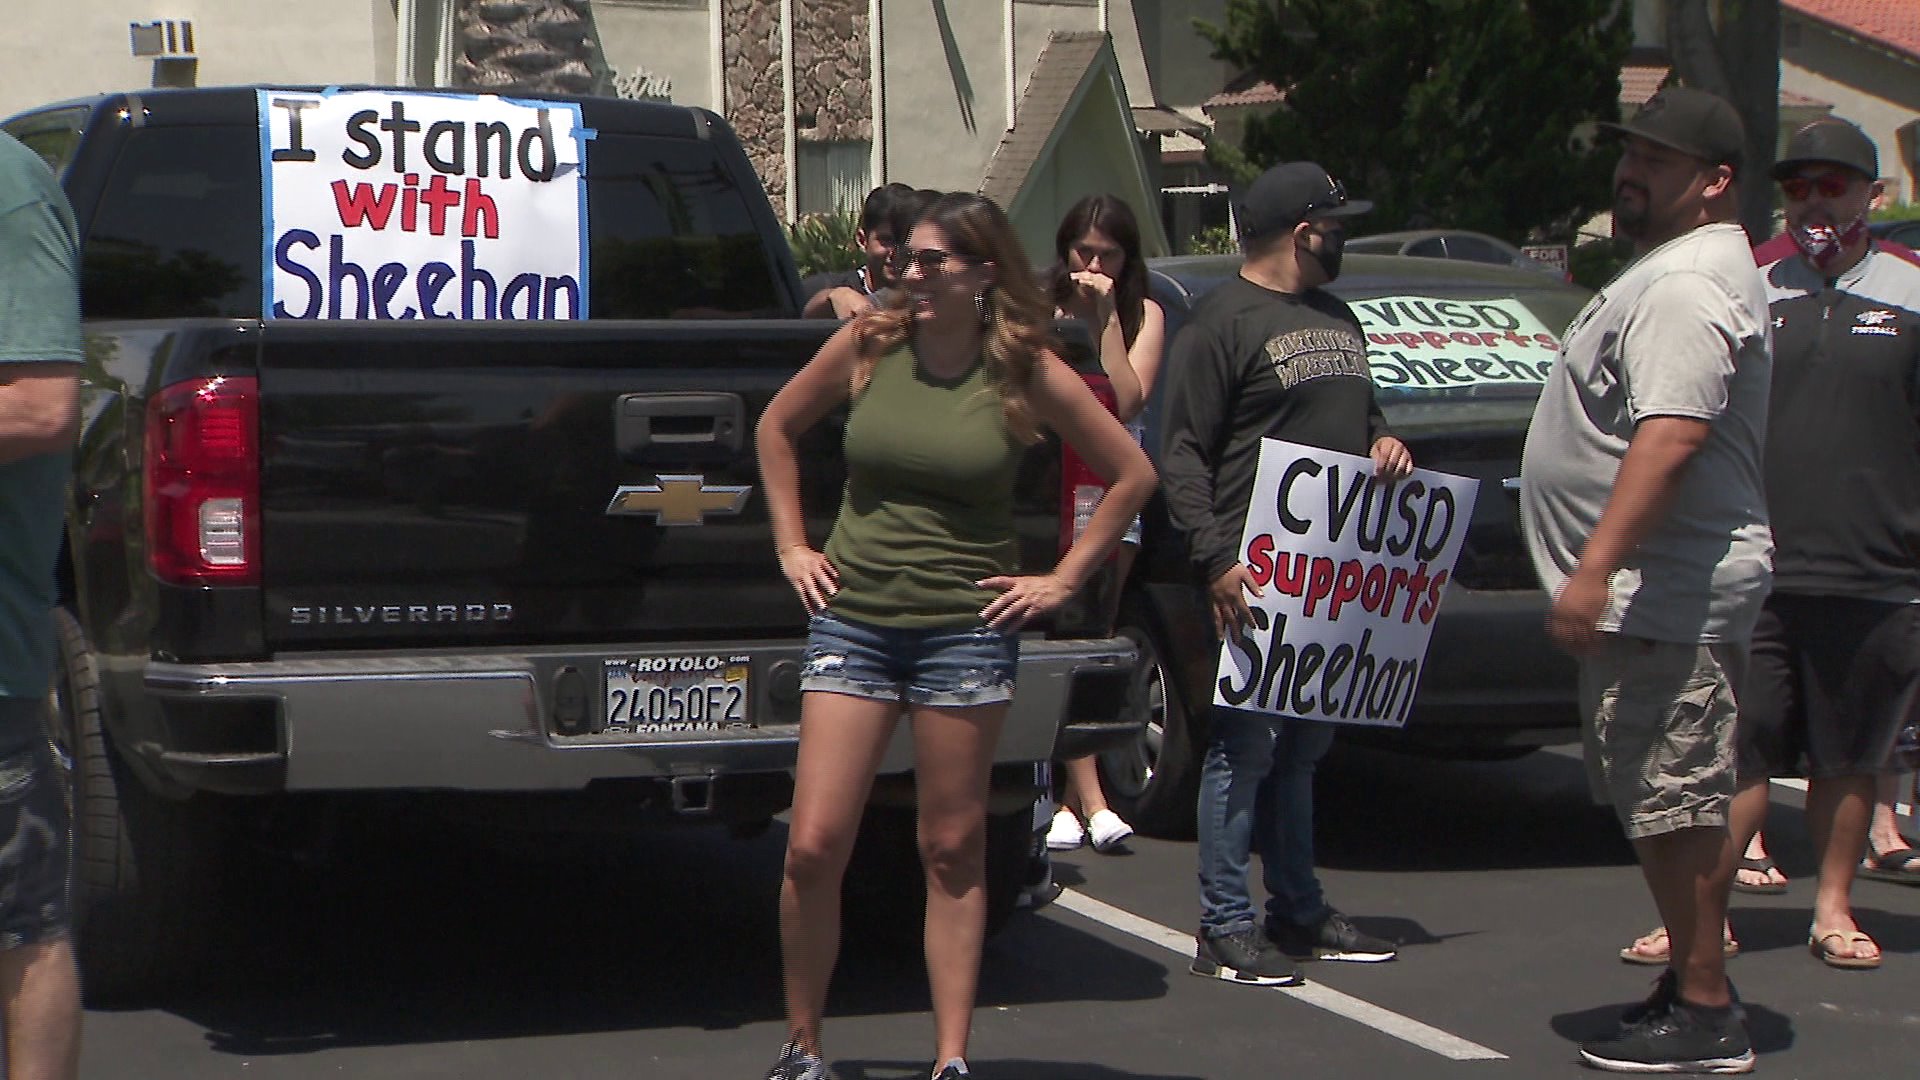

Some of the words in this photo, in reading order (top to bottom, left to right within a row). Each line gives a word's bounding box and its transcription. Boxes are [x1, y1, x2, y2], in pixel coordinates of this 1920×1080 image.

[271, 97, 320, 162] I
[342, 101, 556, 182] stand
[331, 173, 499, 239] with
[272, 228, 580, 320] Sheehan
[1361, 300, 1521, 330] VUSD
[1367, 331, 1560, 351] upports
[1277, 457, 1455, 562] CVUSD
[291, 603, 513, 624] SILVERADO
[1219, 606, 1418, 723] Sheehan
[608, 684, 743, 725] 24050F2
[635, 722, 720, 734] FONTANA
